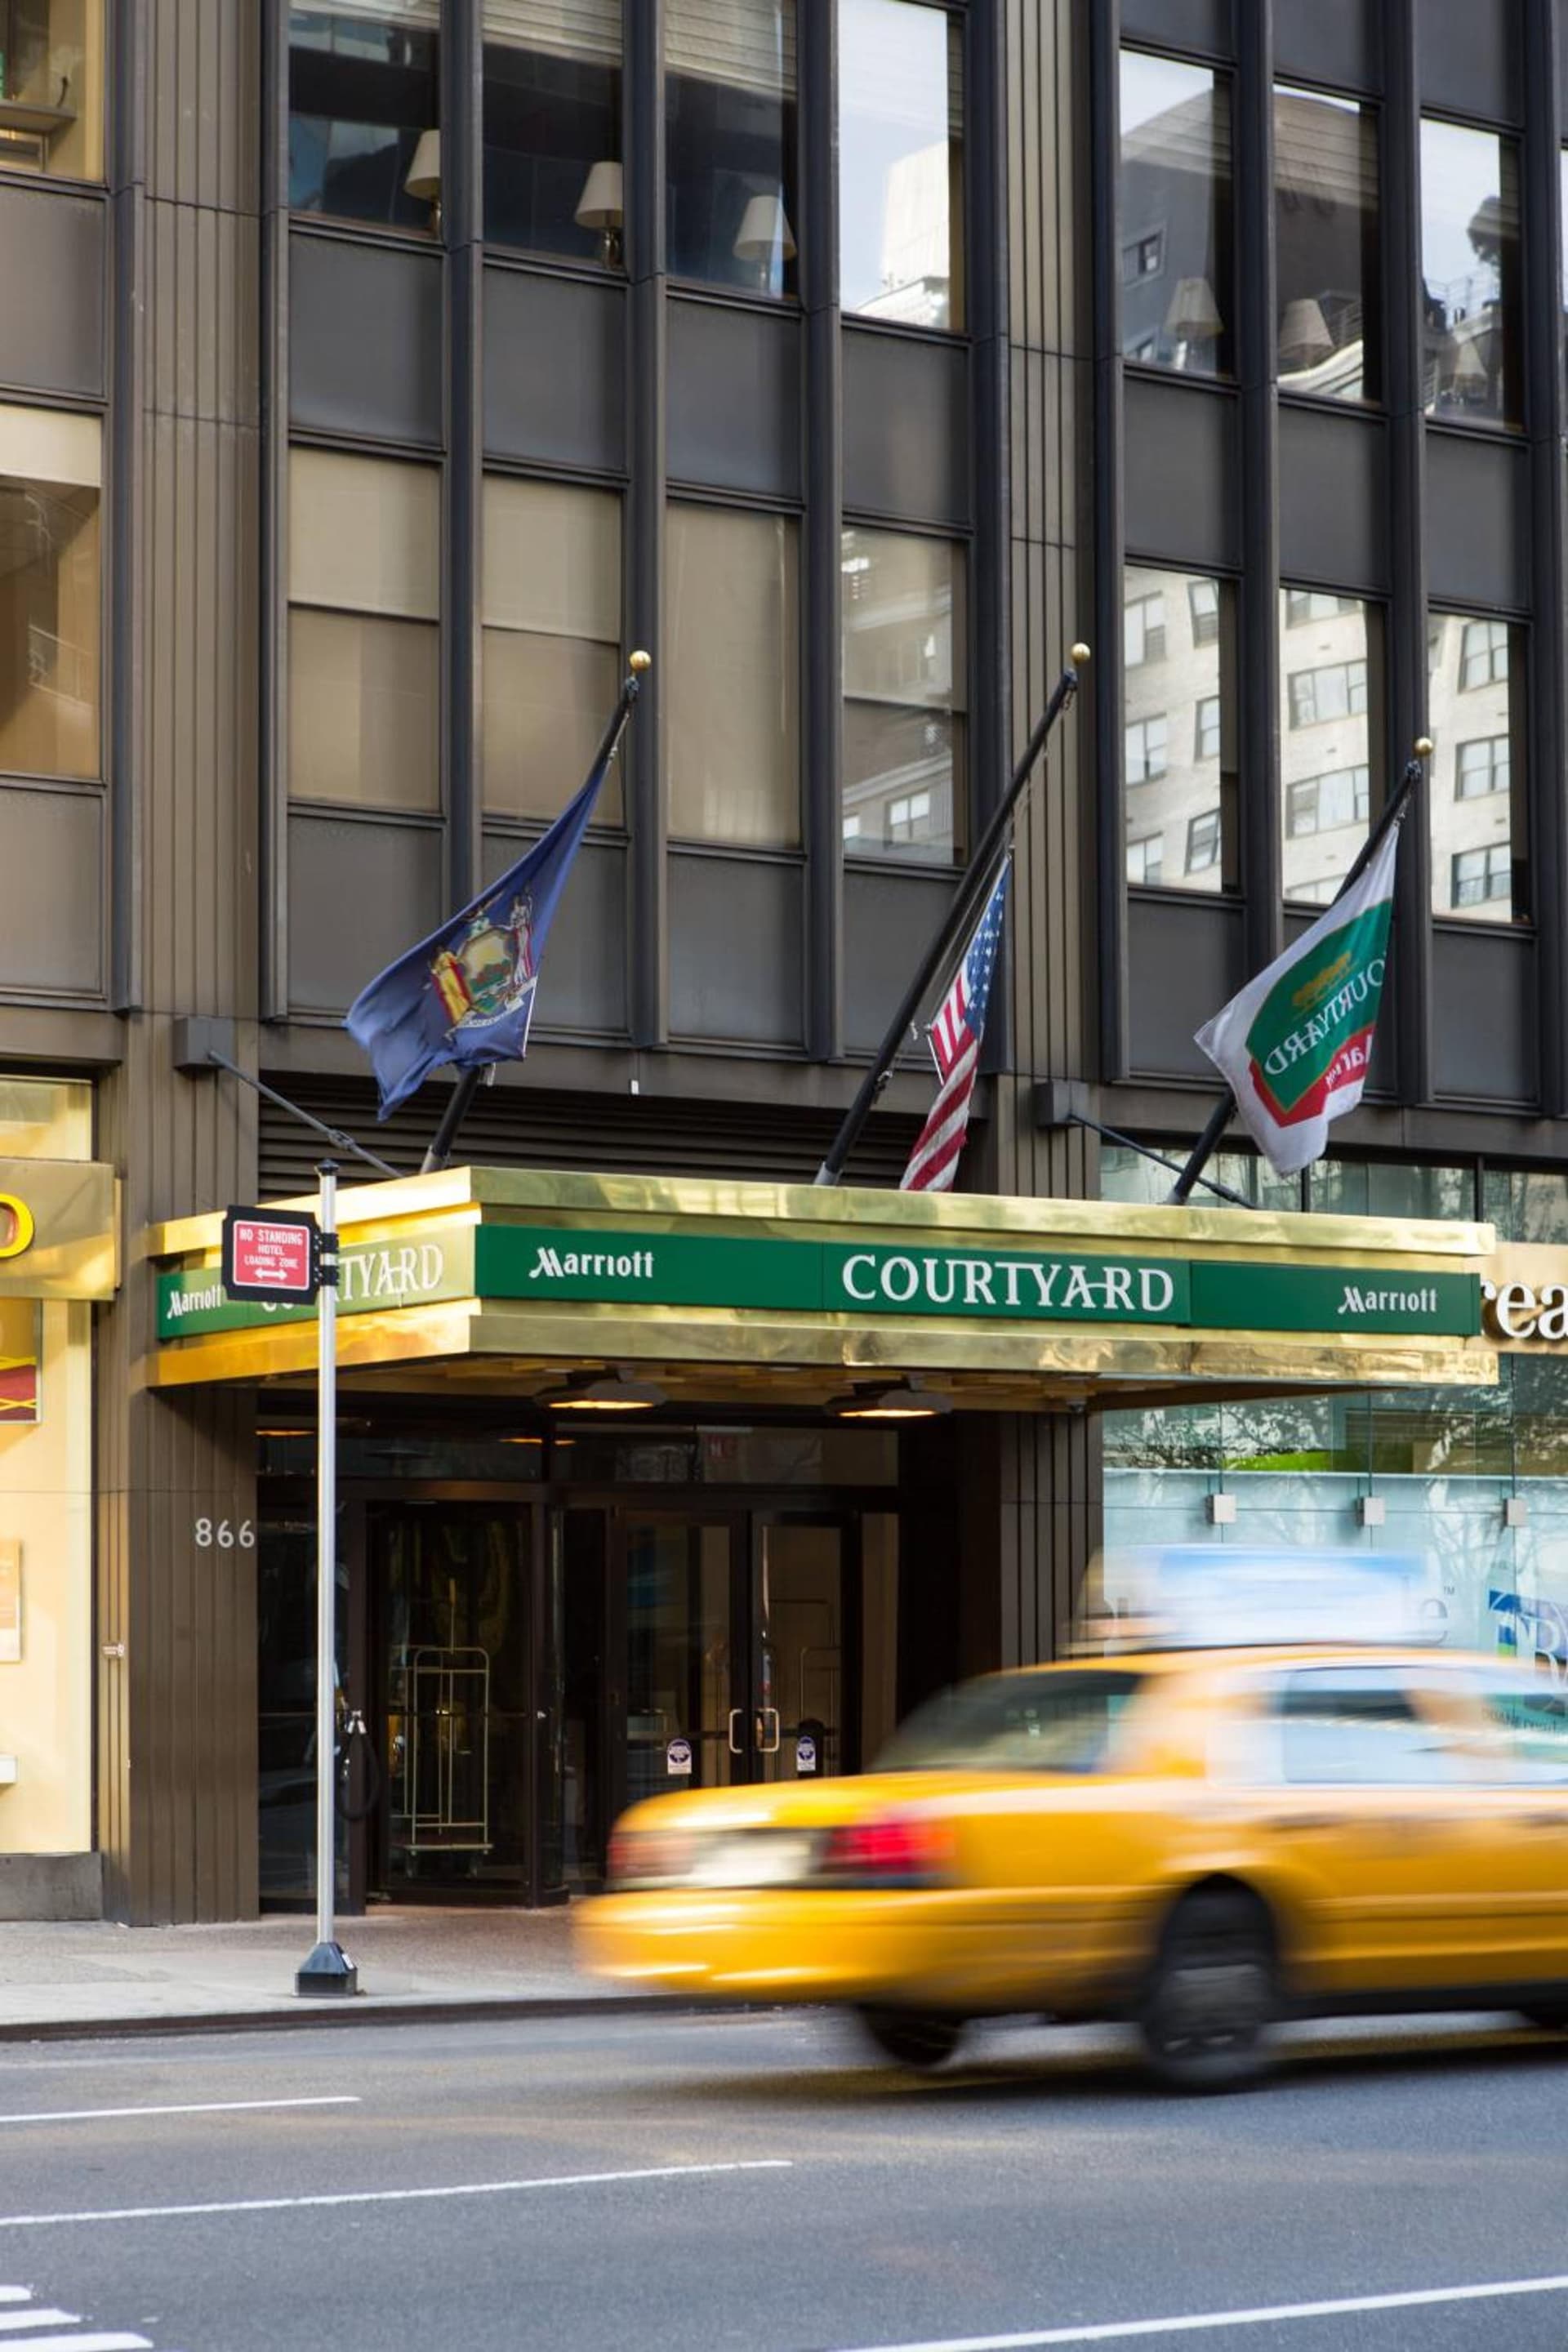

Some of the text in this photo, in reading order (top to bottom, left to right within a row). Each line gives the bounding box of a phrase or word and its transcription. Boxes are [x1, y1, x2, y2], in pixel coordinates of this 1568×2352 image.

[239, 1227, 303, 1245] NO STANDING
[258, 1244, 284, 1255] HOTEL
[244, 1255, 299, 1269] LOADING ZONE
[529, 1247, 653, 1278] Marriott
[167, 1244, 443, 1320] Marriott TYARD
[842, 1254, 1174, 1312] COURTYARD
[1337, 1286, 1437, 1313] Marriott
[196, 1517, 255, 1548] 866
